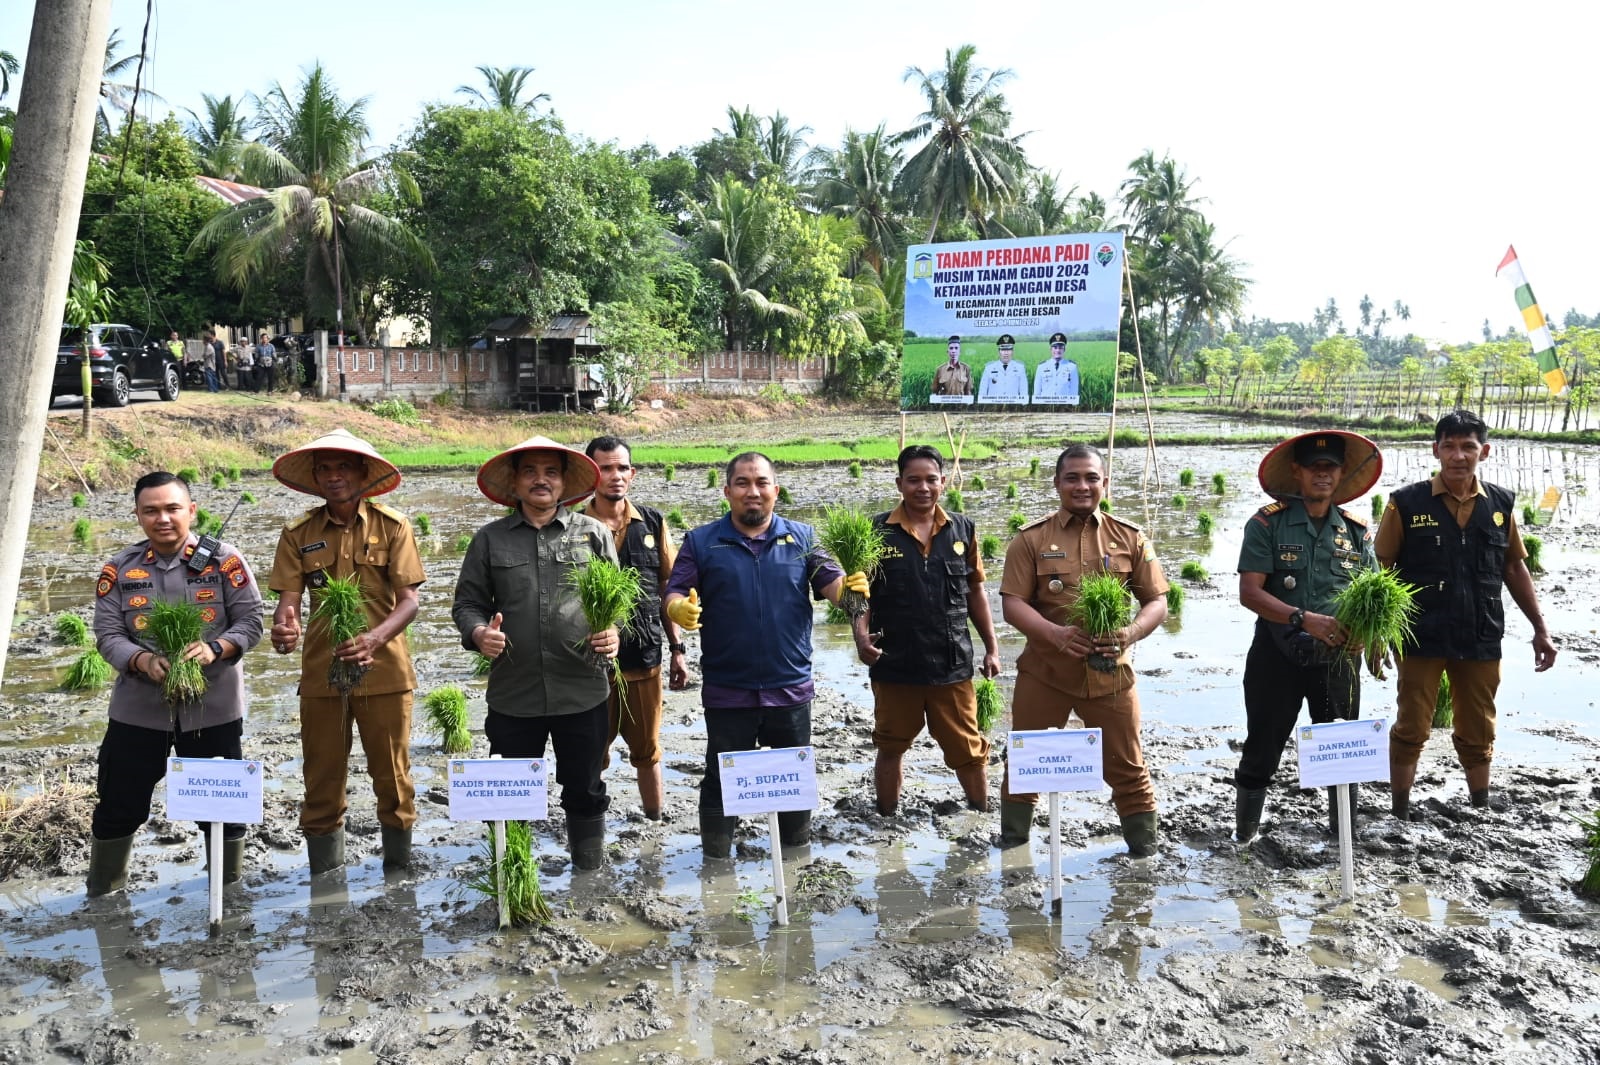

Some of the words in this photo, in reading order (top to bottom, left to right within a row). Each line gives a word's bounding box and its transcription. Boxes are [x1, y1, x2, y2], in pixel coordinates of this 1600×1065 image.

[936, 250, 983, 269] TANAM
[986, 245, 1051, 266] PERDANA
[1055, 243, 1090, 262] PADI
[933, 270, 974, 284] MUSIM
[977, 268, 1018, 282] TANAM
[1021, 265, 1054, 280] GADU
[1056, 263, 1089, 278] 2024
[934, 283, 1001, 298] KETAHANAN
[1004, 281, 1052, 295] PANGAN
[1055, 279, 1087, 293] DESA
[945, 300, 954, 309] DI
[955, 298, 1006, 309] KECAMATAN
[1008, 297, 1036, 307] DARUL
[1038, 295, 1074, 305] IMARAH
[956, 309, 1005, 319] KABUPATEN
[1006, 308, 1030, 317] ACEH
[1032, 306, 1061, 317] BESAR
[1413, 514, 1435, 524] PPL
[880, 546, 900, 555] PPL
[121, 582, 154, 591] HENDRA
[187, 576, 219, 586] POLRI
[1318, 739, 1369, 752] DANRAMIL
[1038, 755, 1073, 764] CAMAT
[1309, 752, 1340, 762] DARUL
[1341, 748, 1377, 759] IMARAH
[1018, 767, 1052, 776] DARUL
[1054, 765, 1093, 774] IMARAH
[188, 777, 242, 788] KAPOLSEK
[452, 780, 484, 788] KADIS
[487, 779, 543, 788] PERTANIAN
[736, 776, 752, 788] Pj.
[755, 772, 800, 785] BUPATI
[178, 789, 209, 797] DARUL
[211, 790, 249, 799] IMARAH
[465, 790, 494, 798] ACEH
[496, 789, 531, 797] BESAR
[737, 791, 765, 800] ACEH
[767, 788, 801, 798] BESAR
